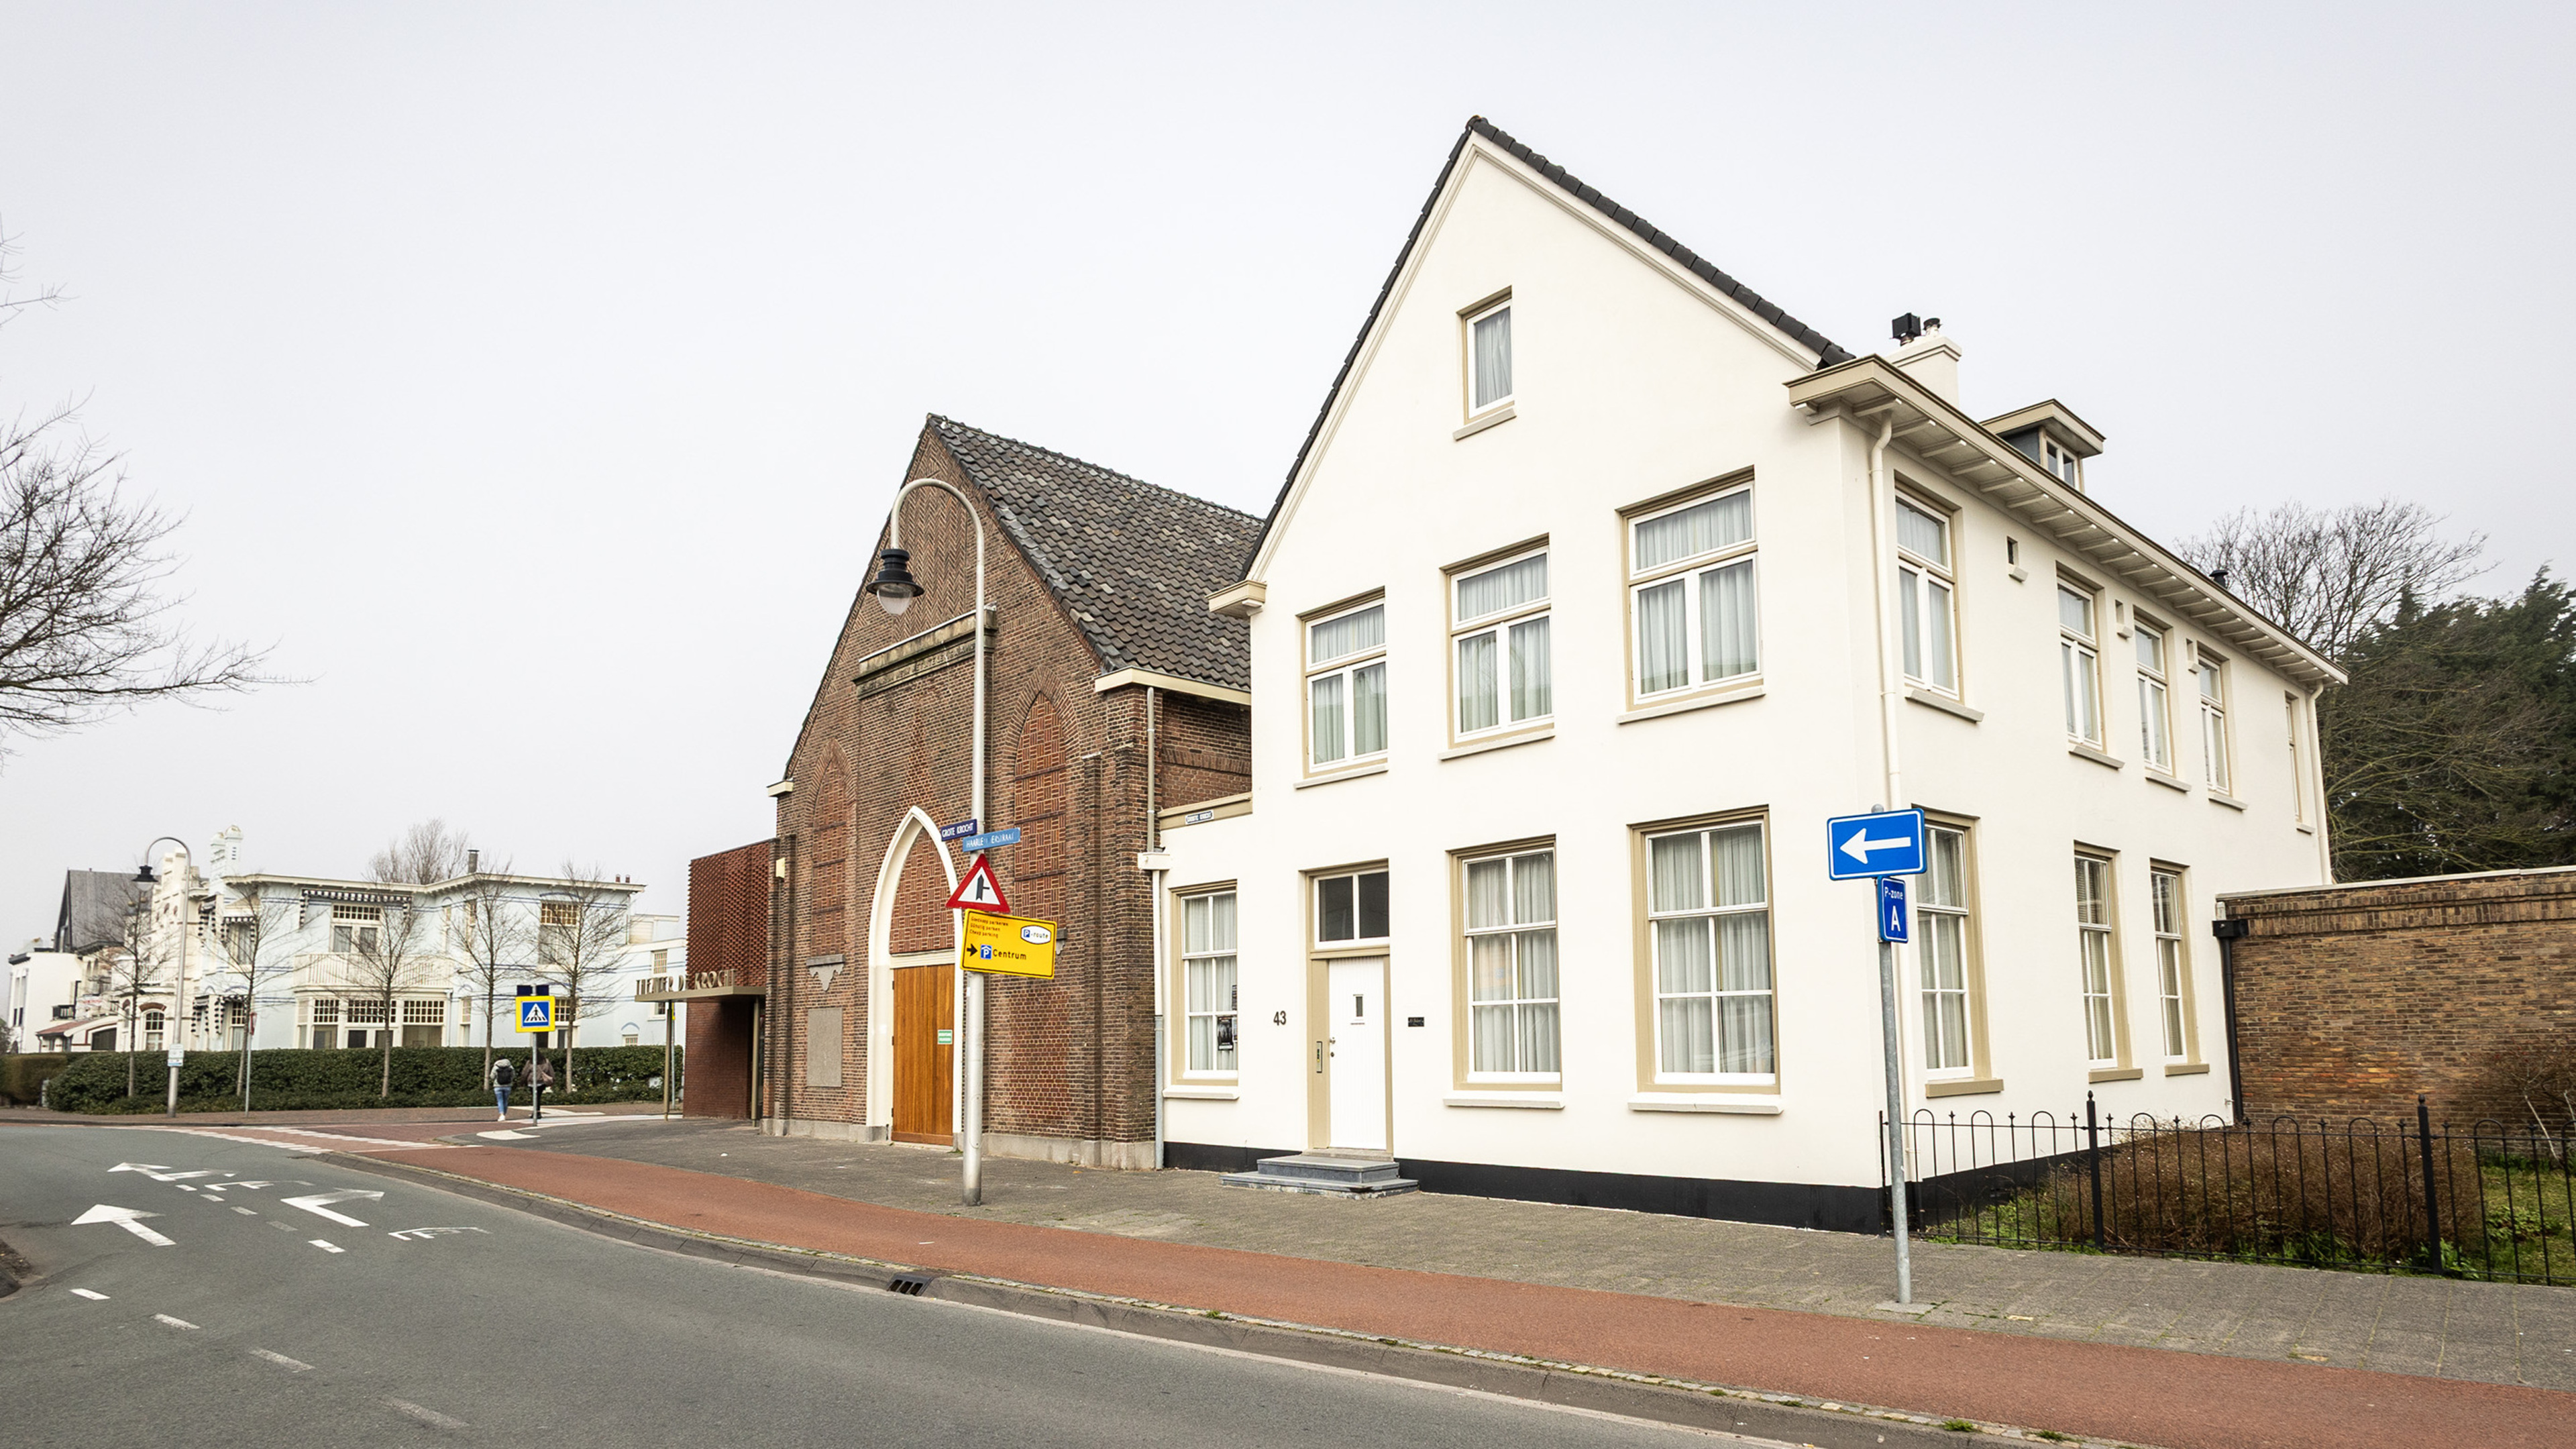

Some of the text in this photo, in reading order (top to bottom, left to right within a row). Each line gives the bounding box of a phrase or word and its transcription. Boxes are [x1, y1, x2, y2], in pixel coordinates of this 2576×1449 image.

[942, 822, 973, 837] GROTE KROCHT
[1884, 886, 1903, 900] P-zone
[1891, 906, 1900, 931] A
[993, 949, 1026, 960] Centrum
[1273, 1011, 1287, 1026] 43
